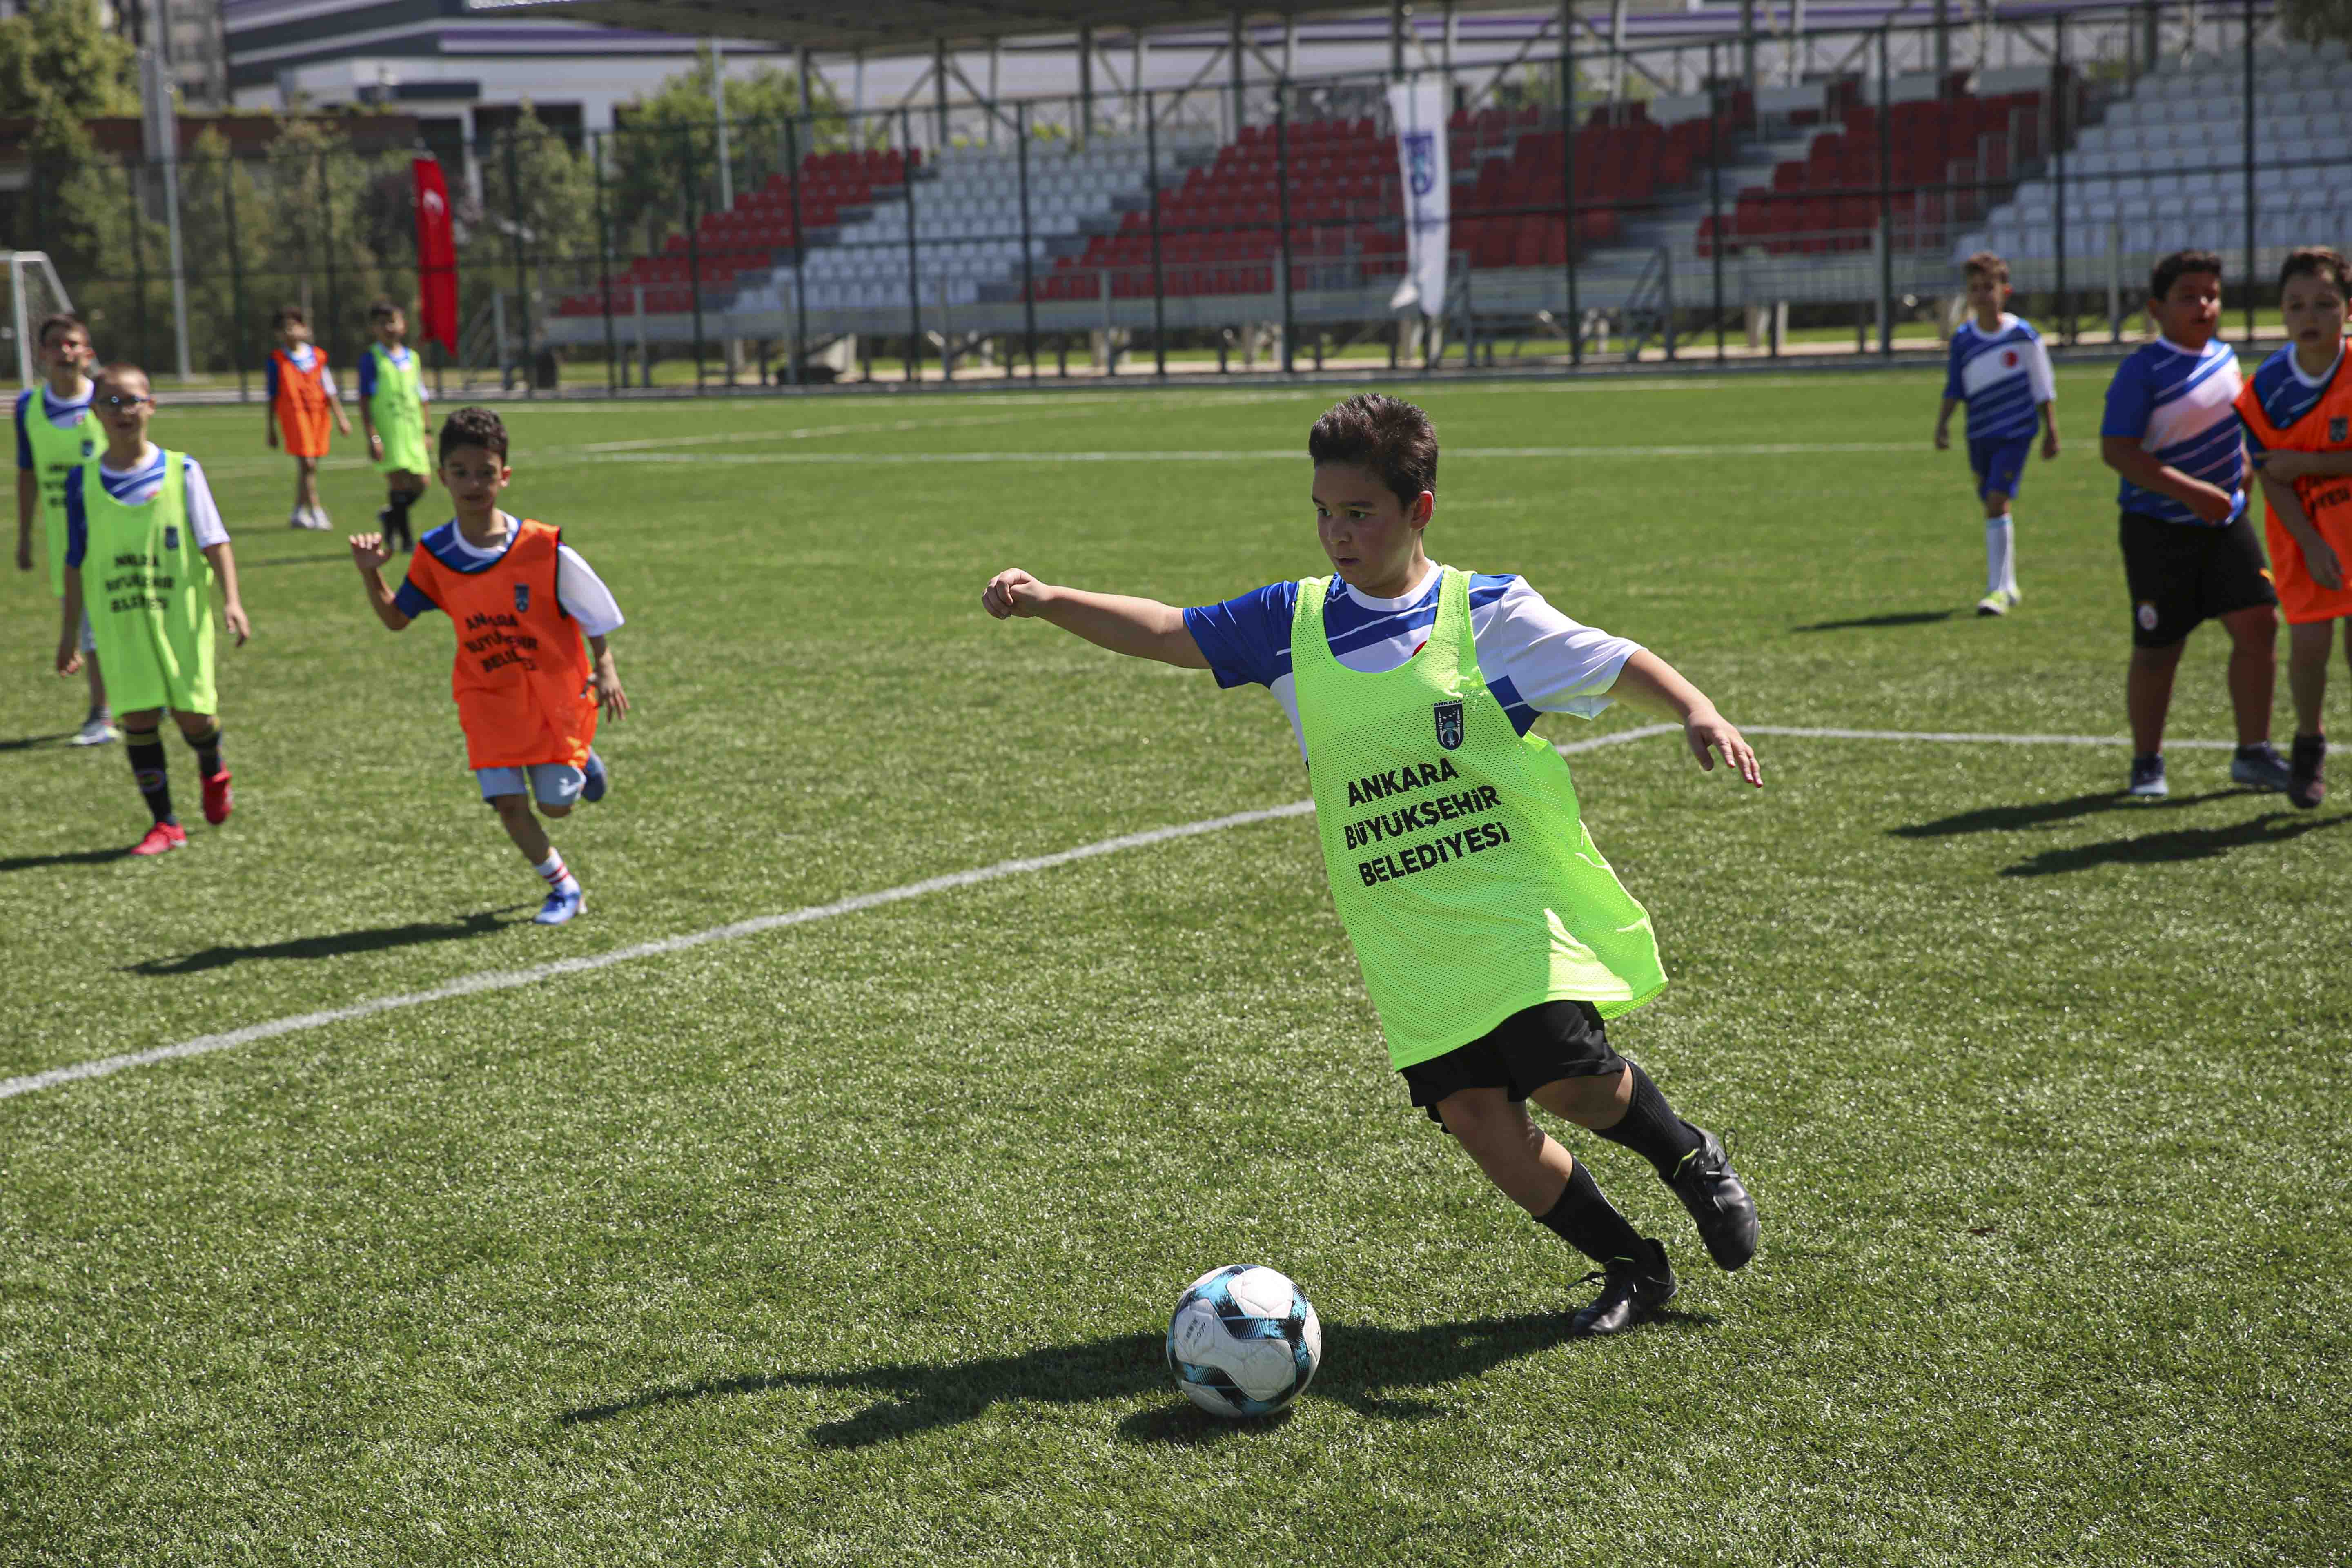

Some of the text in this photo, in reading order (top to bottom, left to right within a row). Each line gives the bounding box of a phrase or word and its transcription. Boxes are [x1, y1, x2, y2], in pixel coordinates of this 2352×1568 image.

[1348, 758, 1460, 807] ANKARA
[1344, 785, 1502, 851] BÜYÜKŞEHİR
[1359, 821, 1510, 887] BELEDİYESİ
